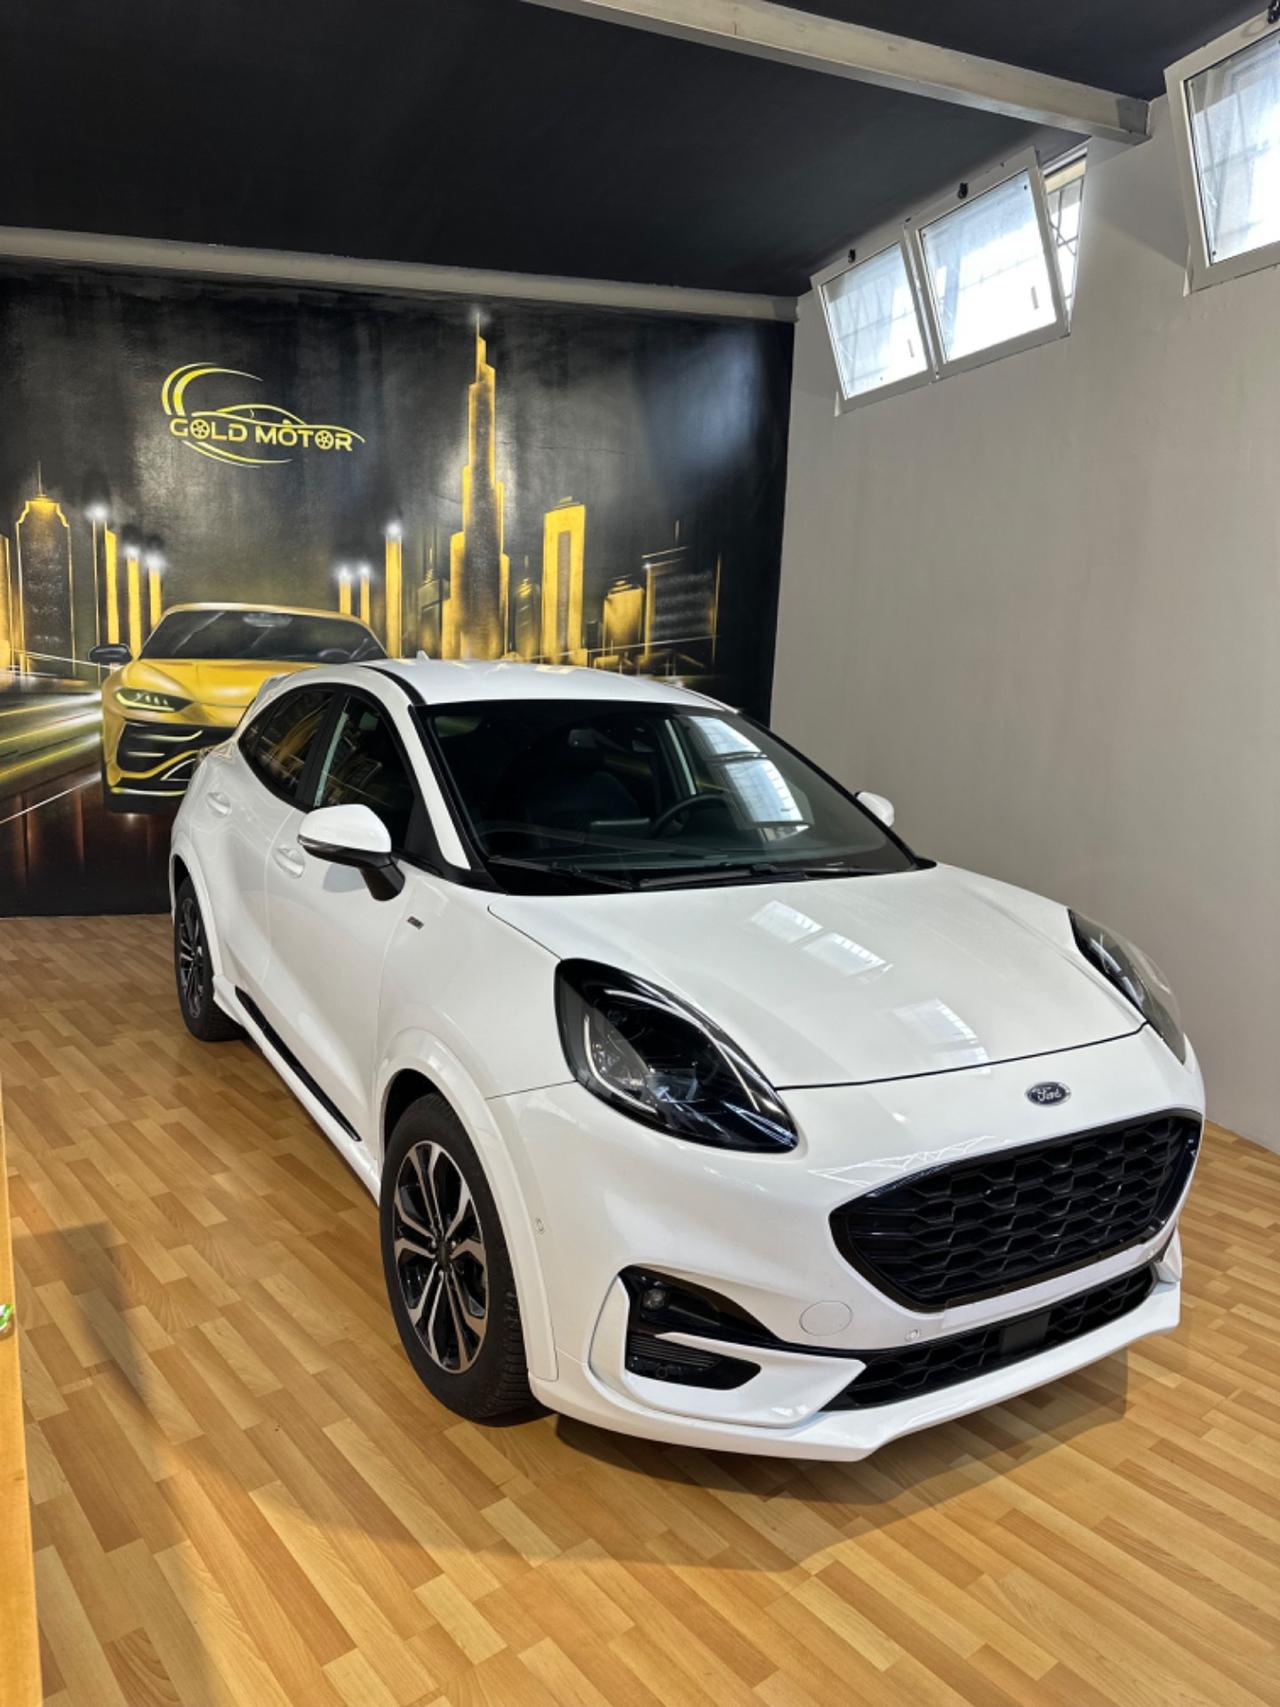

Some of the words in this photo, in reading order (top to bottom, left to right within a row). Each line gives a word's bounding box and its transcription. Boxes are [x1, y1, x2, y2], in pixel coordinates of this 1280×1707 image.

[169, 418, 248, 442] GOLD
[255, 424, 353, 451] MOTOR
[1031, 1086, 1062, 1101] Ford
